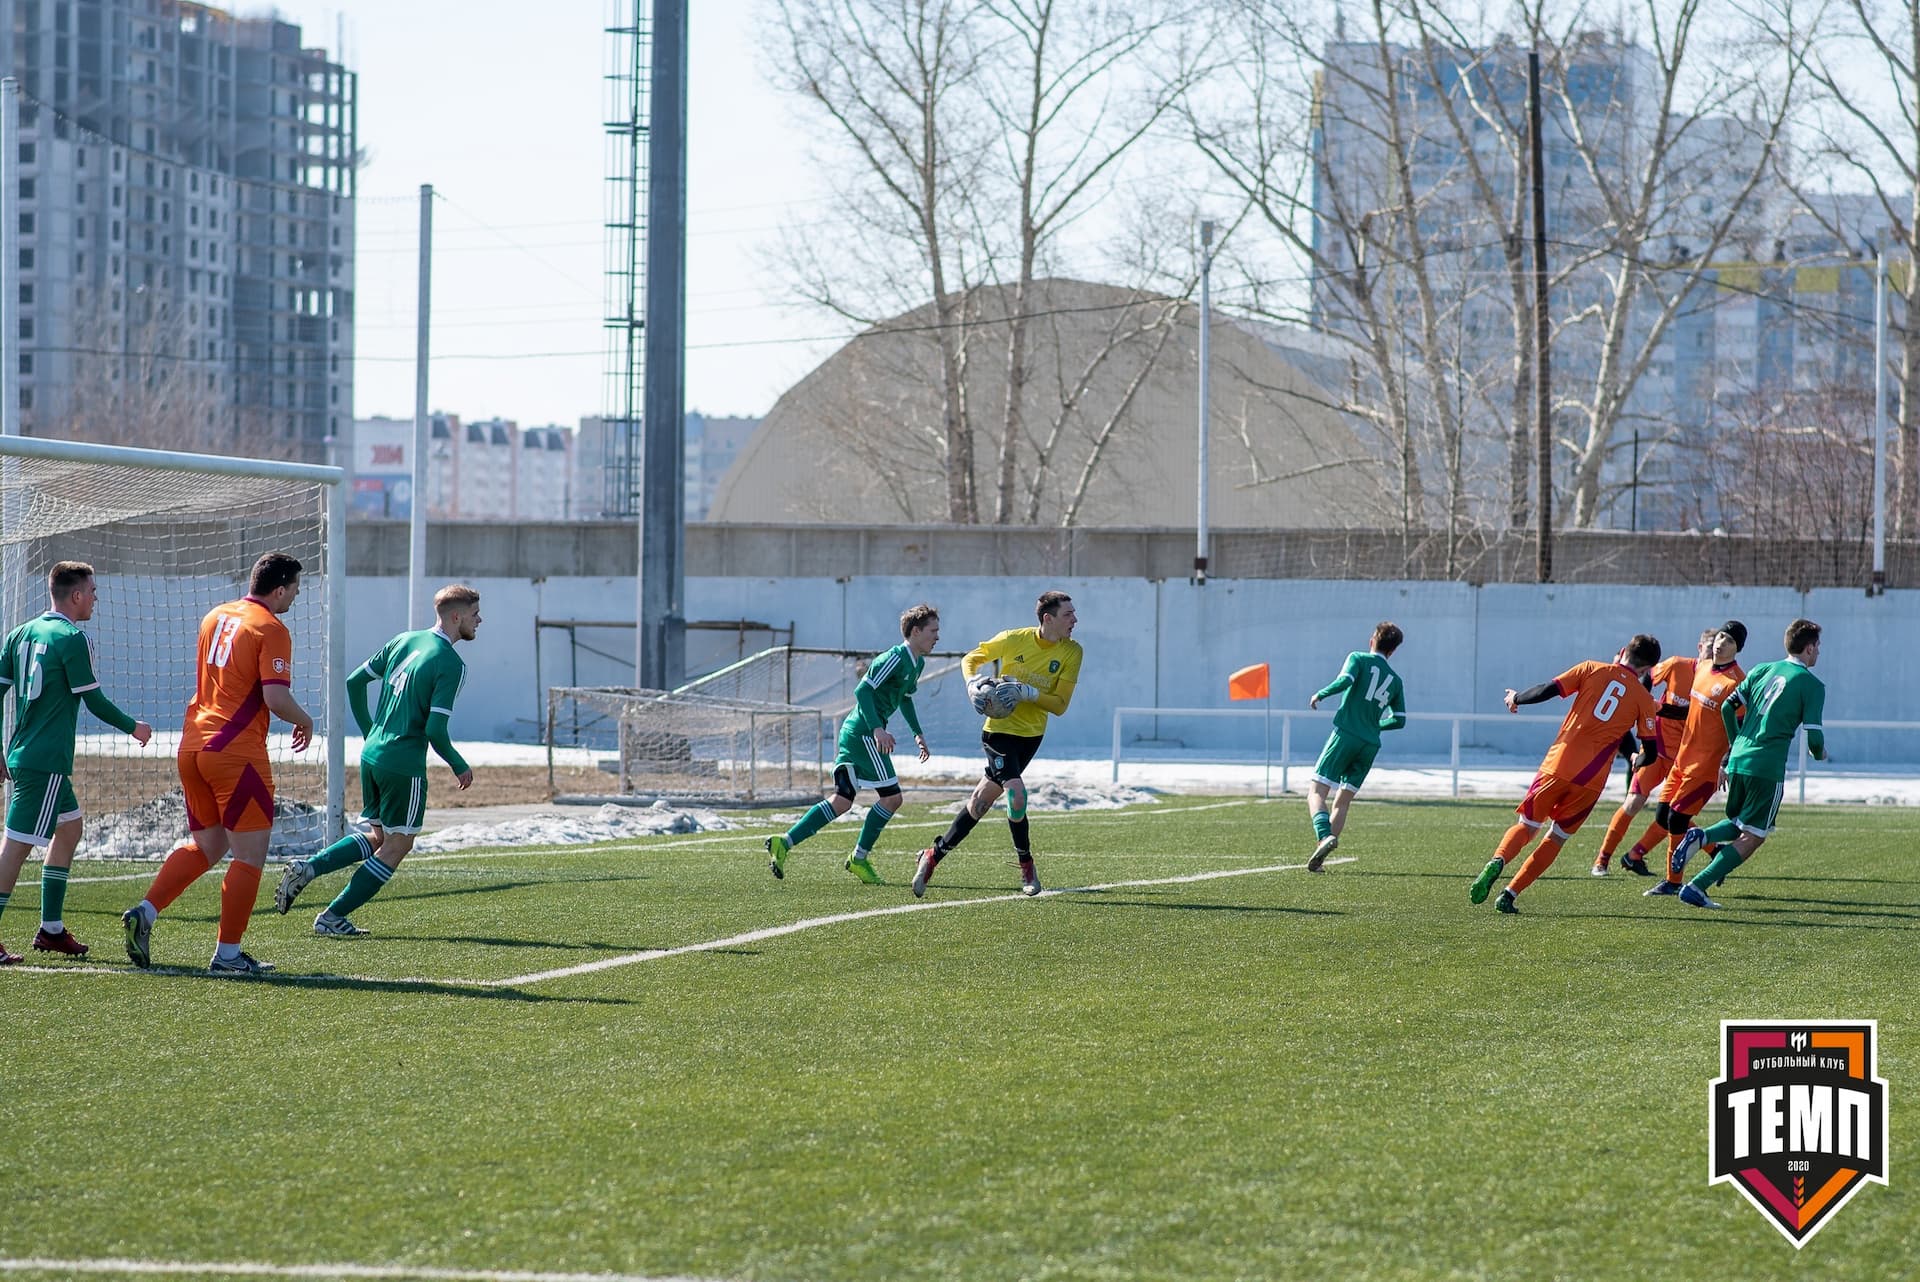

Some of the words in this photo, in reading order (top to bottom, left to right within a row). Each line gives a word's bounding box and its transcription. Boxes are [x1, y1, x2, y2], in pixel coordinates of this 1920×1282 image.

[206, 614, 243, 669] 13
[17, 641, 48, 700] 15
[388, 649, 420, 697] 4
[1365, 665, 1394, 709] 14
[1593, 680, 1627, 722] 6
[1758, 675, 1787, 715] 9
